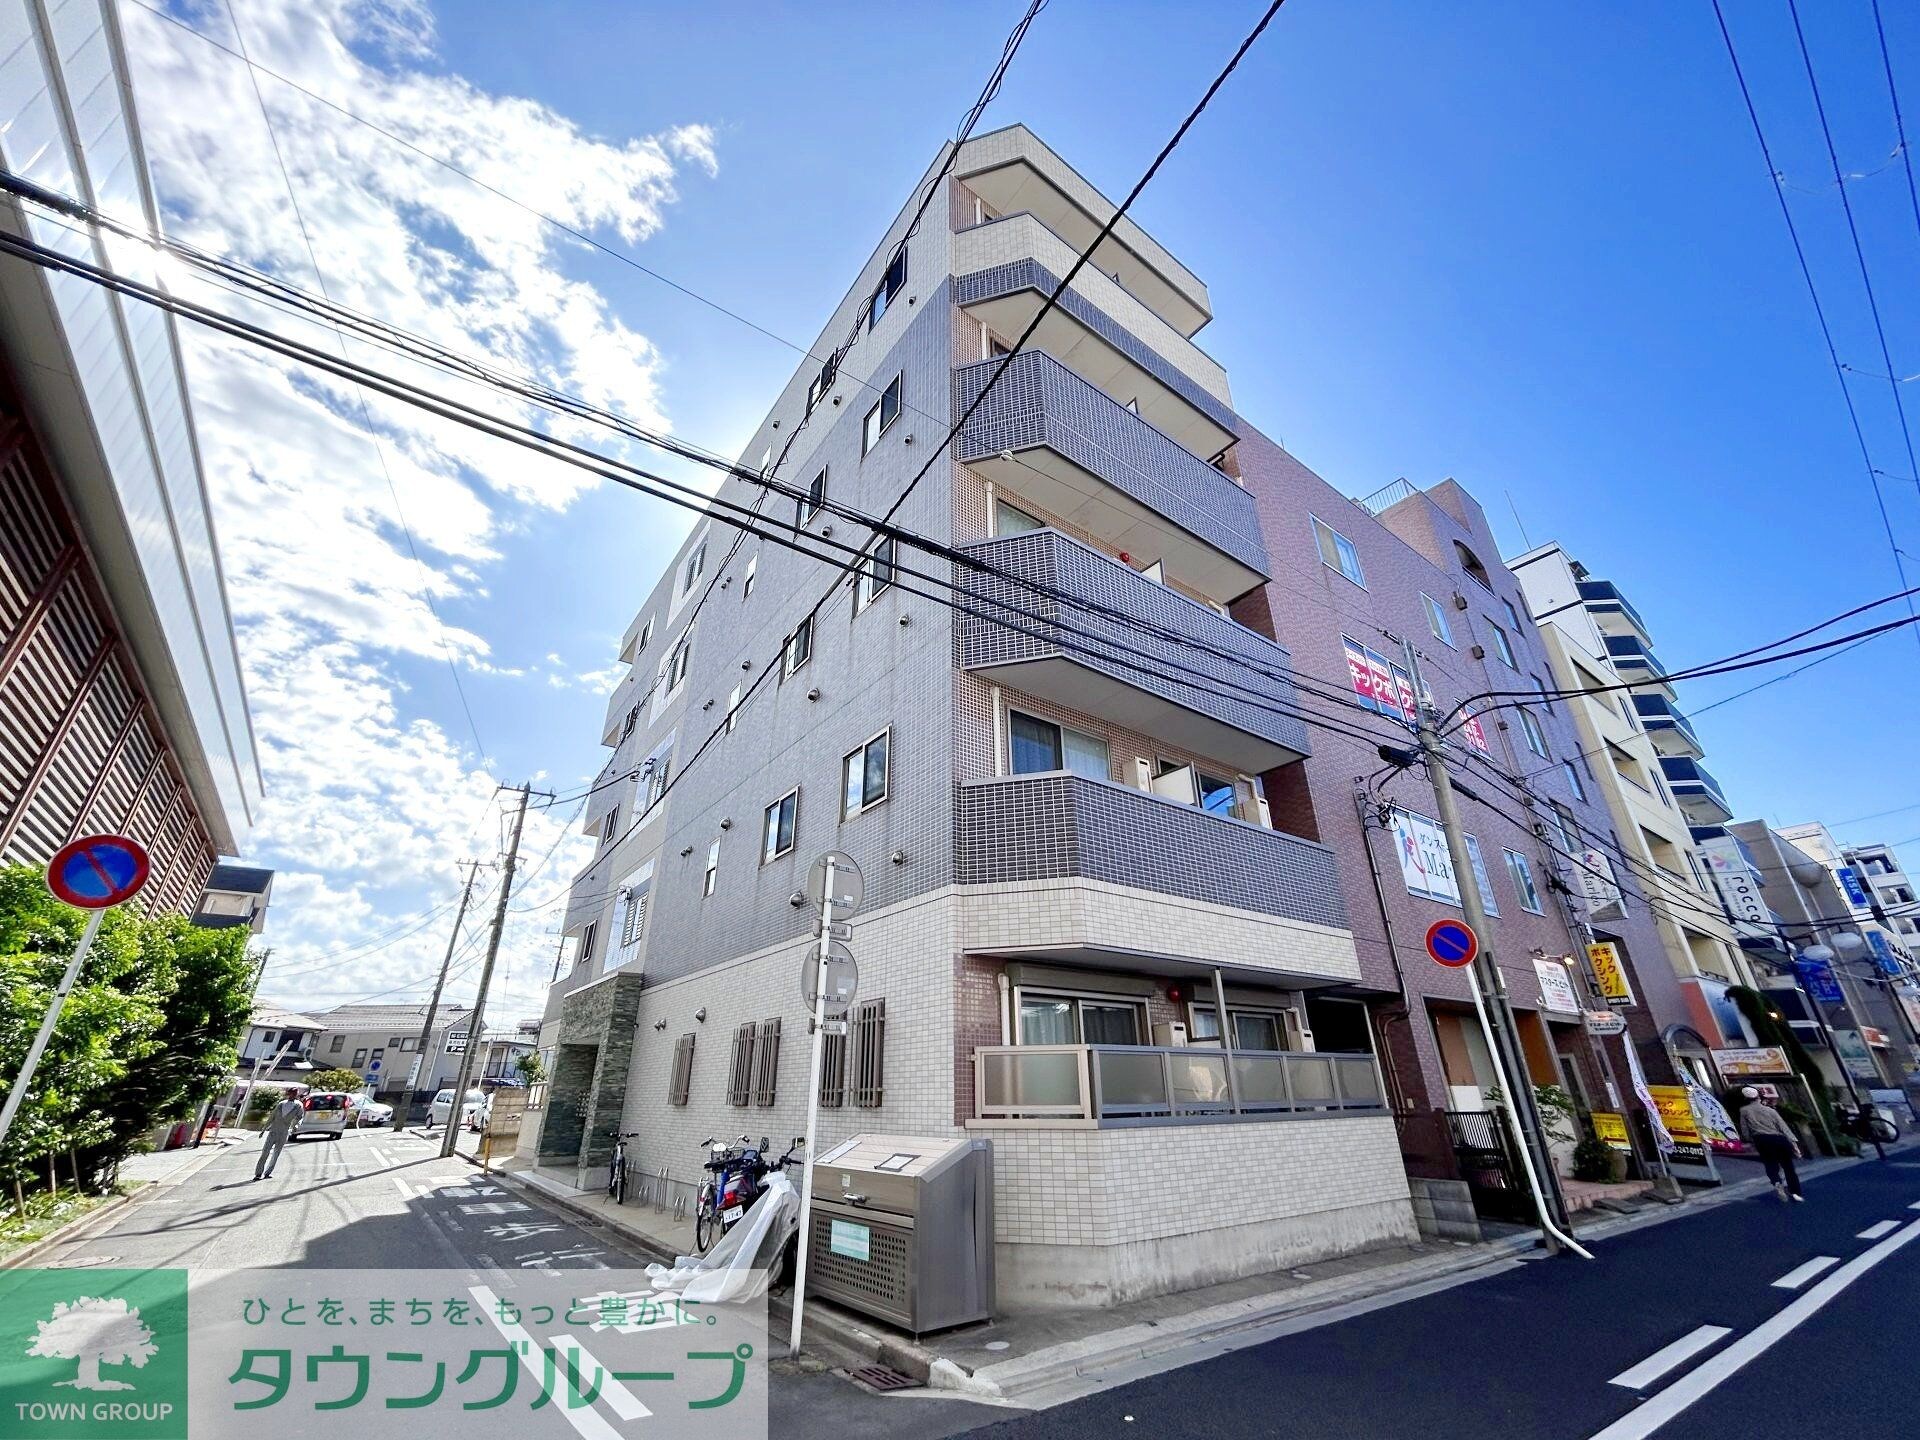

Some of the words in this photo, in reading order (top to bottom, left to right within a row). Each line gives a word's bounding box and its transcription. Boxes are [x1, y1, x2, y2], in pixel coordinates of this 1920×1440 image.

[1732, 876, 1761, 922] rocco
[1591, 948, 1612, 994] ボクシング
[1601, 947, 1616, 973] キック
[1673, 1146, 1704, 1156] 3-247-0112
